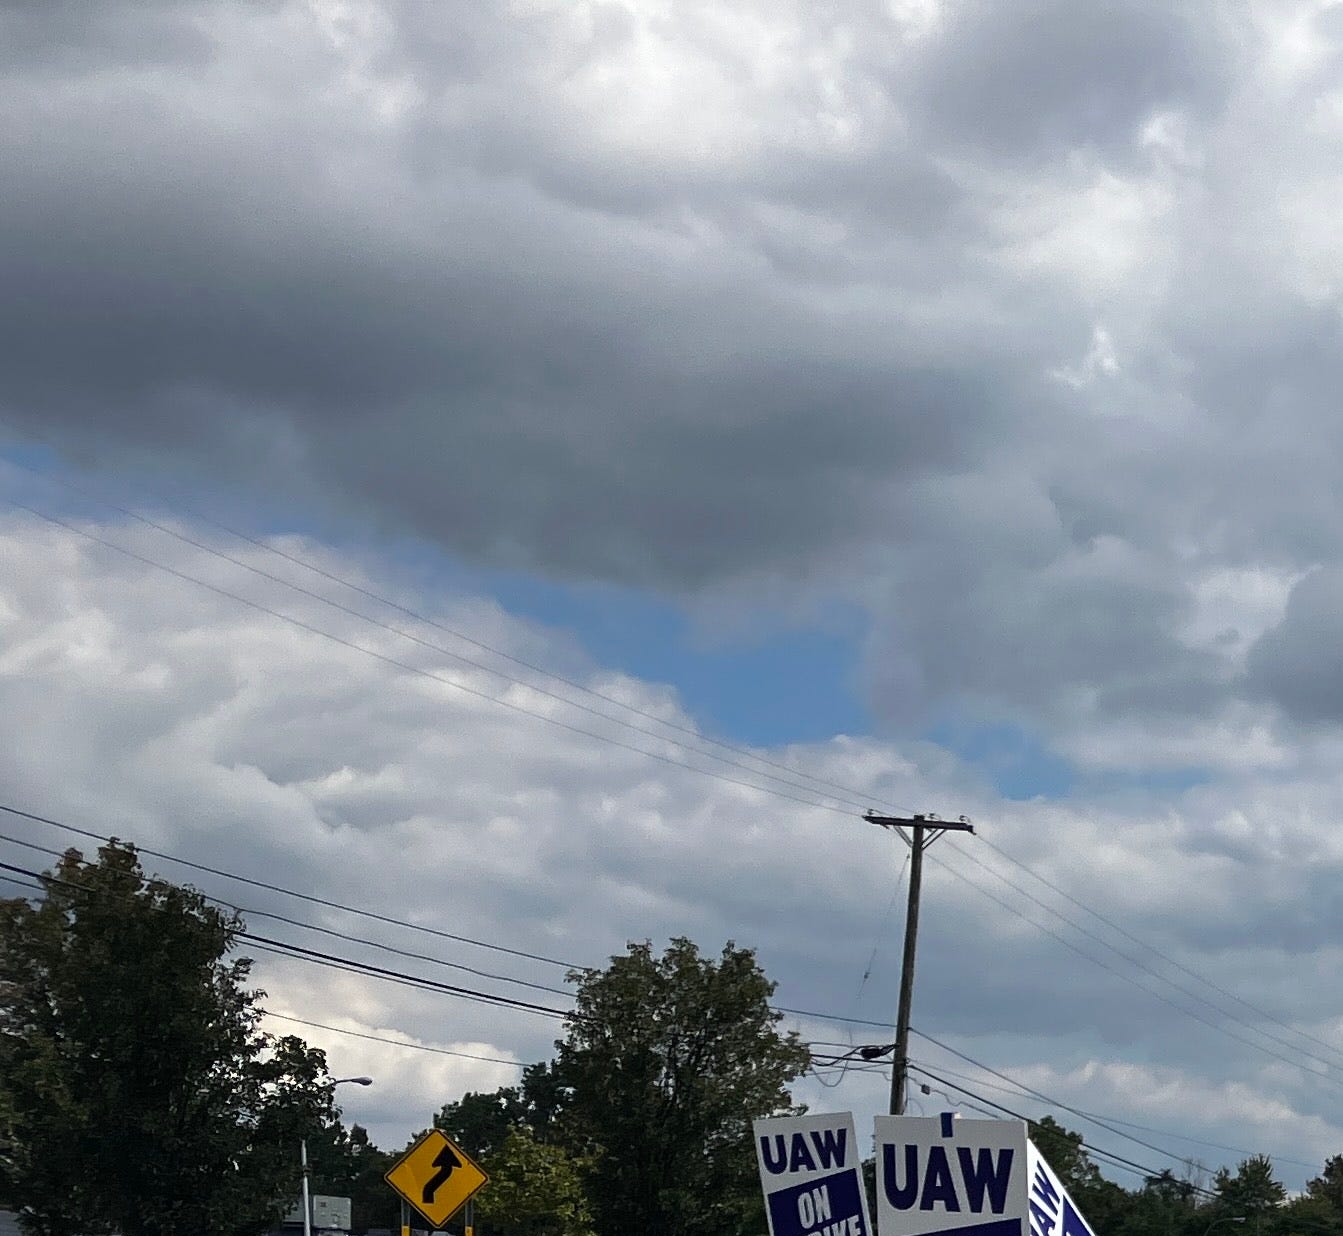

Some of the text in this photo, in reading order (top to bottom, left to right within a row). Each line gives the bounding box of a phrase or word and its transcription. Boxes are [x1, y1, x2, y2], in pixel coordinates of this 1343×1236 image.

[760, 1128, 848, 1174] UAW
[883, 1143, 1015, 1214] UAW
[798, 1184, 832, 1230] ON
